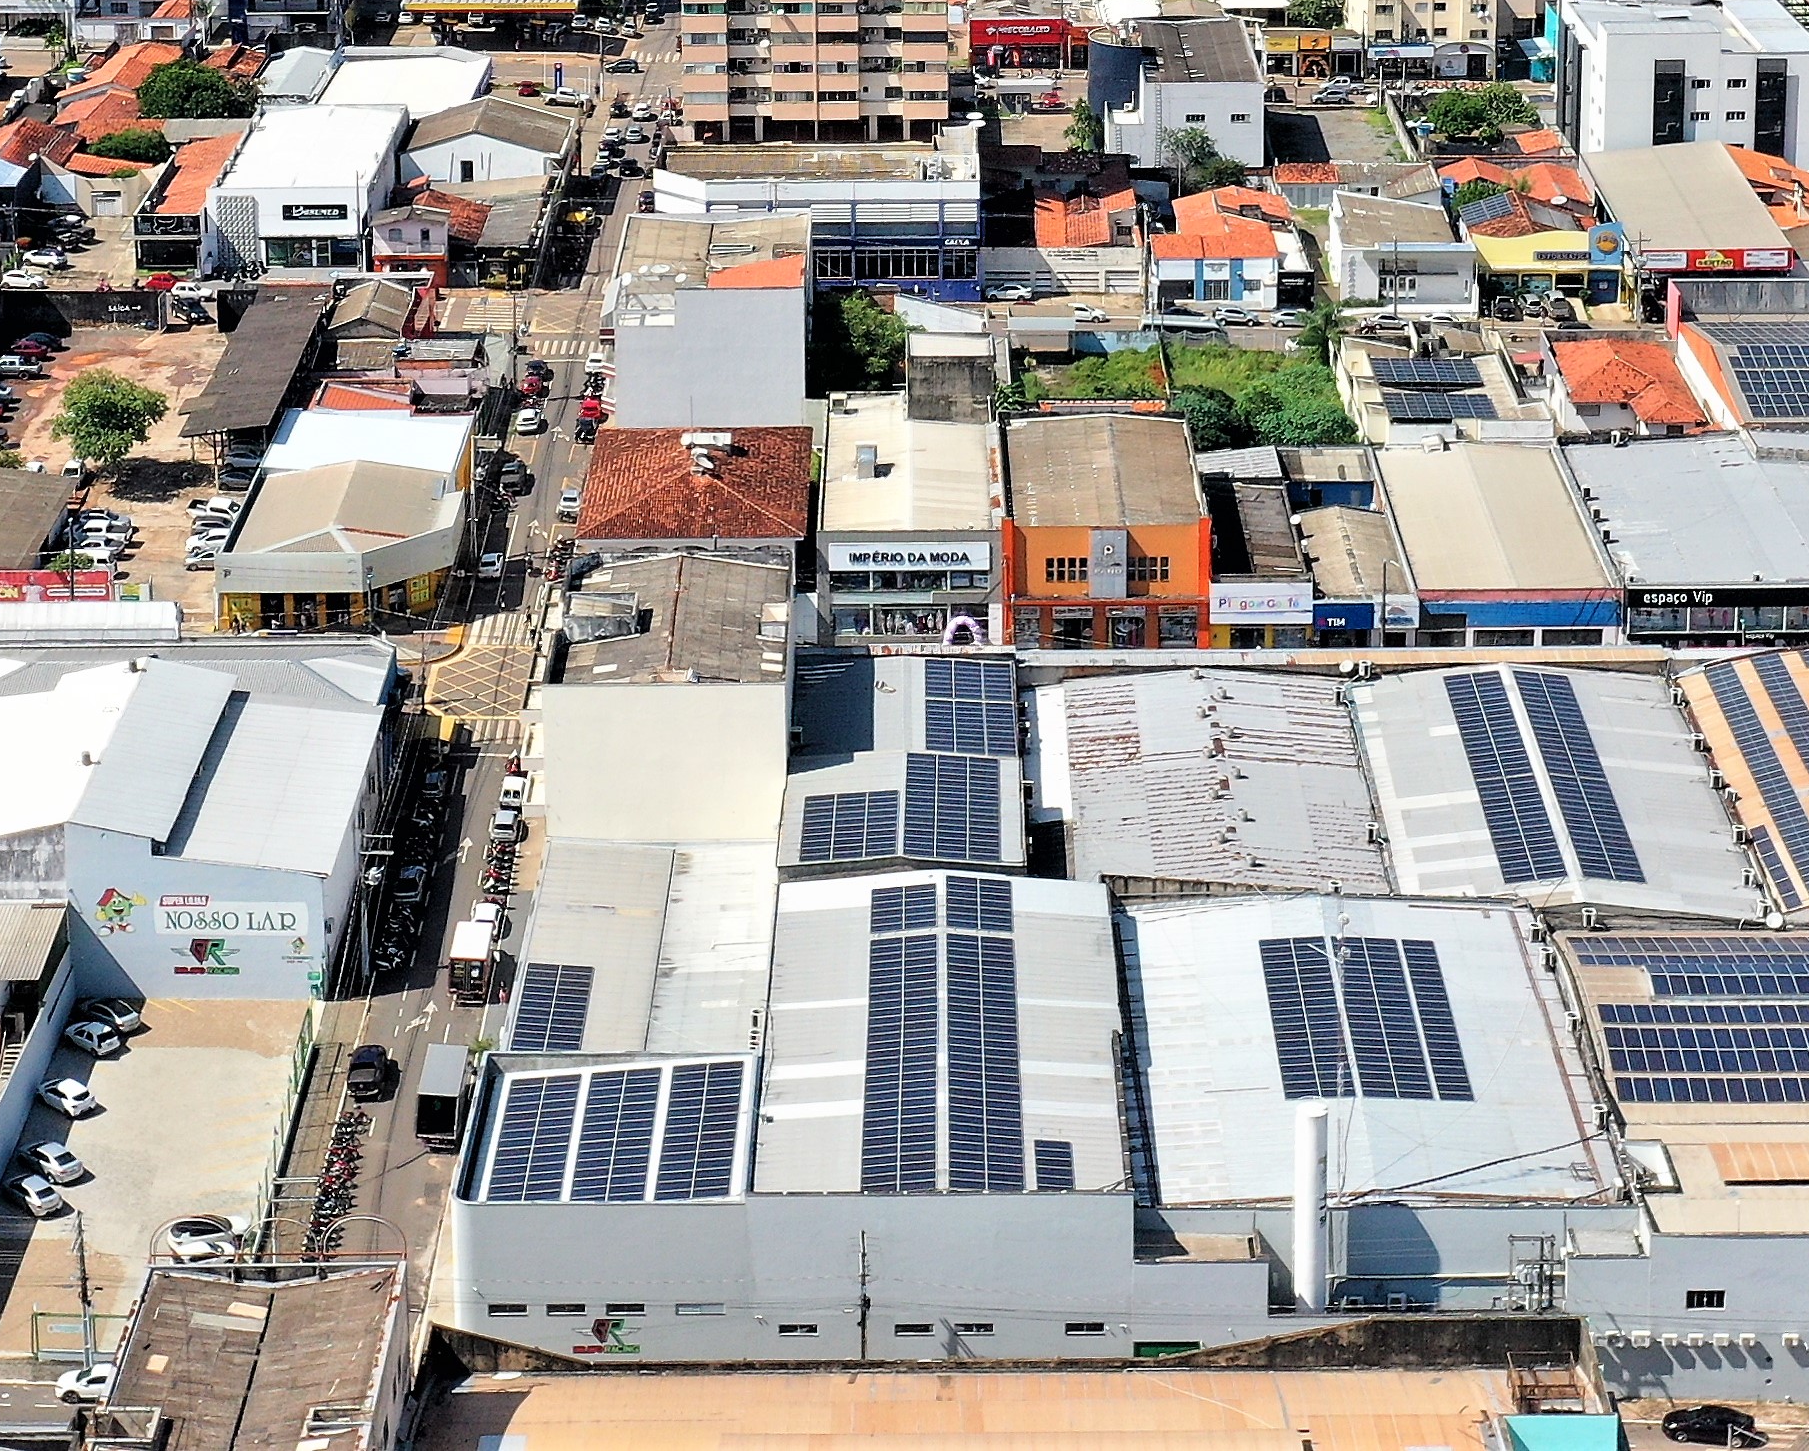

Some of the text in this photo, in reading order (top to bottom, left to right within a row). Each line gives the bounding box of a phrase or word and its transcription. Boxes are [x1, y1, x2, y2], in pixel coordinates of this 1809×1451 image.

[849, 549, 970, 563] IMPÉRIO DA MODA
[1643, 590, 1713, 605] espaço Vip
[1327, 617, 1346, 627] TIM
[164, 910, 297, 931] NOSSO LAR
